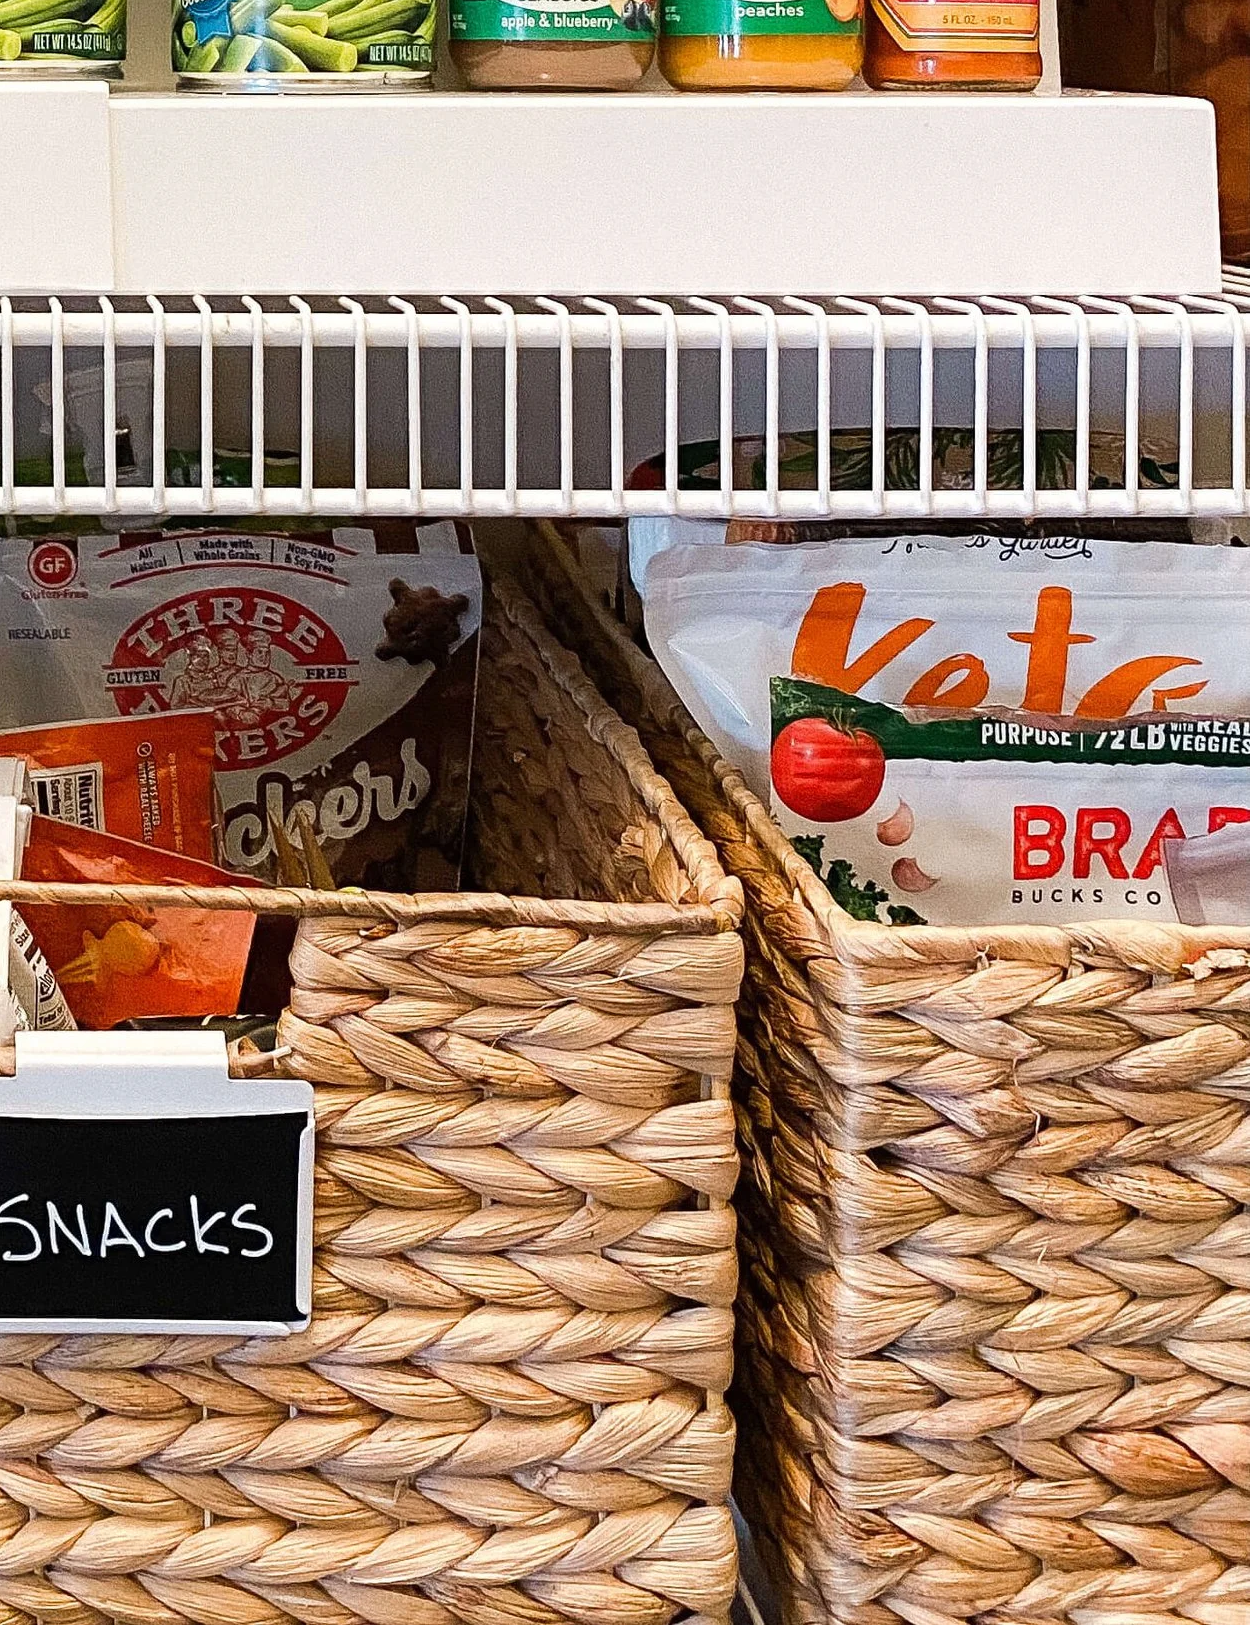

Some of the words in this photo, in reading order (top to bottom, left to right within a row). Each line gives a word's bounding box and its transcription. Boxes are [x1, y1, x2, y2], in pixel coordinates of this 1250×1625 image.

[736, 3, 804, 18] peaches
[501, 14, 535, 30] apple
[539, 14, 550, 28] &
[554, 14, 613, 31] blueberry
[34, 34, 49, 50] NET
[52, 34, 63, 50] WT
[194, 550, 226, 561] Whole
[288, 543, 335, 563] Non-GMO
[39, 557, 66, 572] GF
[21, 588, 89, 601] Gluten-Free
[8, 628, 71, 641] RESEALABLE
[127, 596, 325, 658] THREE
[107, 670, 161, 684] GLUTEN
[306, 668, 347, 680] FREE
[981, 723, 1072, 747] PURPOSE
[1197, 721, 1250, 736] REAL
[1170, 734, 1250, 754] VEGGIES
[1012, 889, 1104, 904] BUCKS
